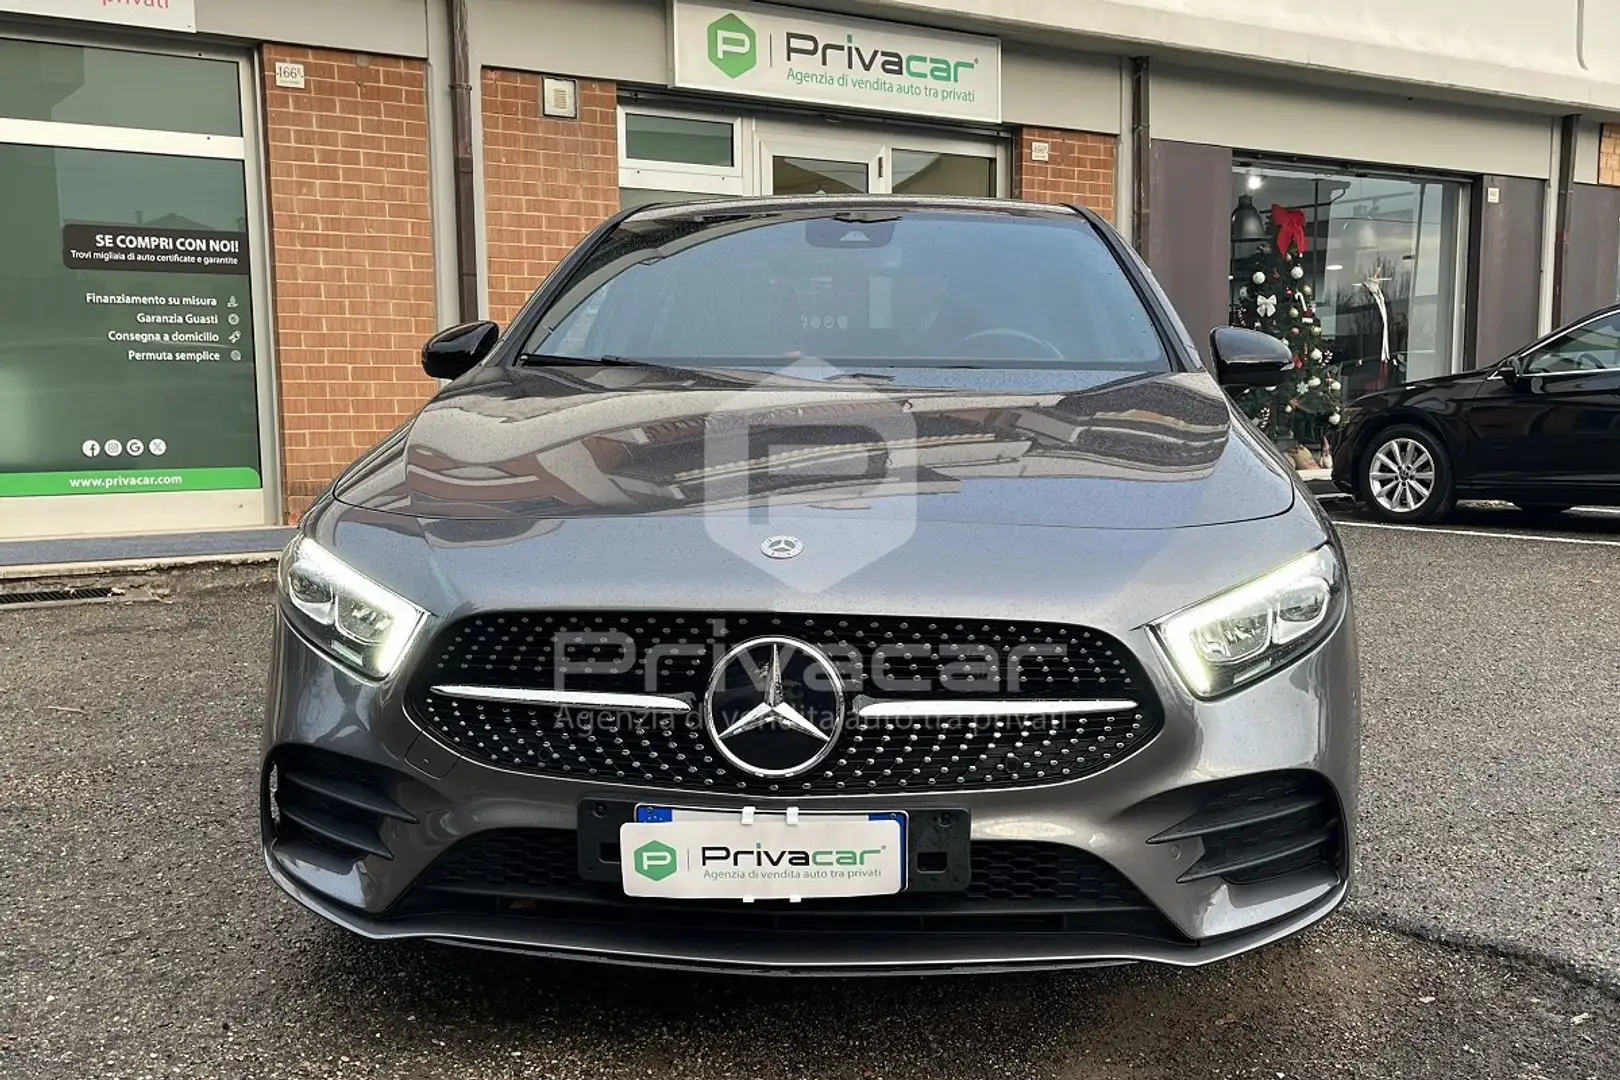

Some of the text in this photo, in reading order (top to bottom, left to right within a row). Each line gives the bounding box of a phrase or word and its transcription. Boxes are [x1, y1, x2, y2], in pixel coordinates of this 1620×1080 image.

[786, 67, 975, 103] Agenzia di vendita auto tra privati
[95, 234, 113, 248] SE
[116, 235, 173, 250] COMPRI
[176, 238, 207, 252] CON
[70, 250, 238, 266] Trovi migliaia di auto certificate e garantite
[86, 293, 217, 307] Finanziamento su misura
[137, 313, 218, 324] Garanzia Guasti
[108, 331, 219, 344] Consegna a domicilio
[128, 350, 220, 363] Permuta semplice
[69, 474, 183, 489] www.privacar.com
[703, 868, 882, 882] Agenzia di vendita auto tra privati
